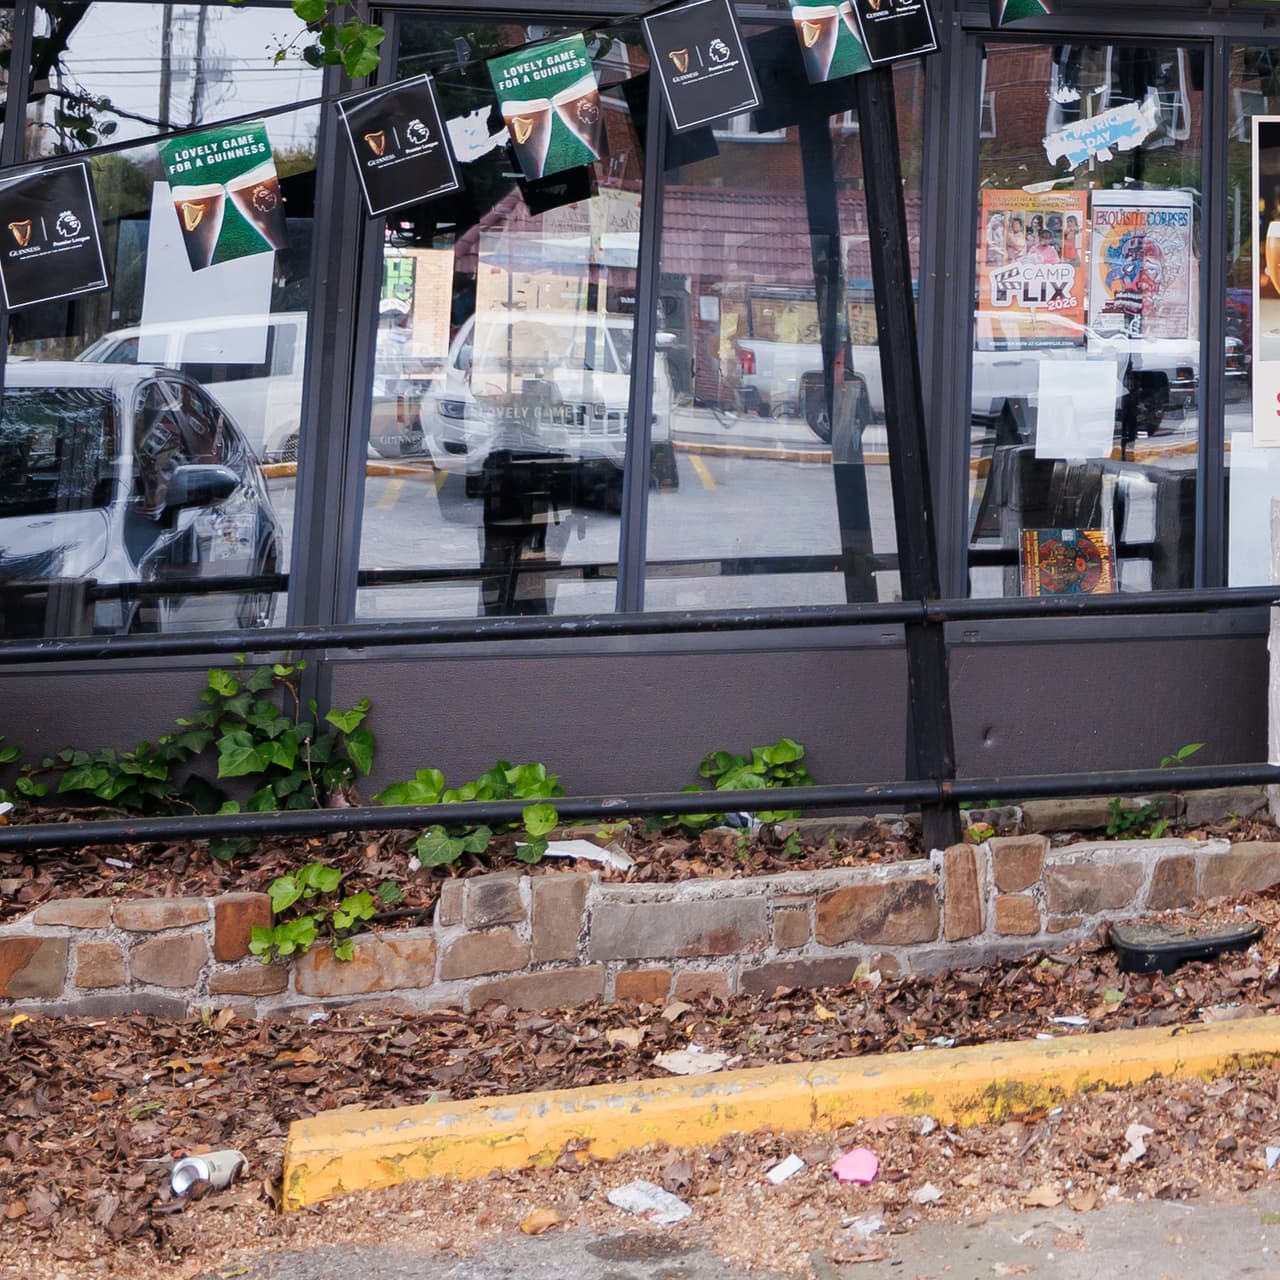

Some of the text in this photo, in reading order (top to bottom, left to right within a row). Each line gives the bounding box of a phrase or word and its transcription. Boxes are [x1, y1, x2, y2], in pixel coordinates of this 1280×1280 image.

[498, 58, 587, 91] FOR A GUINNESS
[504, 50, 577, 77] LOVELY GAME
[174, 134, 256, 162] LOVELY GAME
[1087, 131, 1111, 146] DAY
[169, 142, 266, 175] FOR A GUINNESS
[1094, 210, 1188, 227] EXQUISITE CORPSES
[1022, 267, 1071, 281] CAMP
[996, 280, 1069, 302] FLIX
[1048, 296, 1077, 311] 2026
